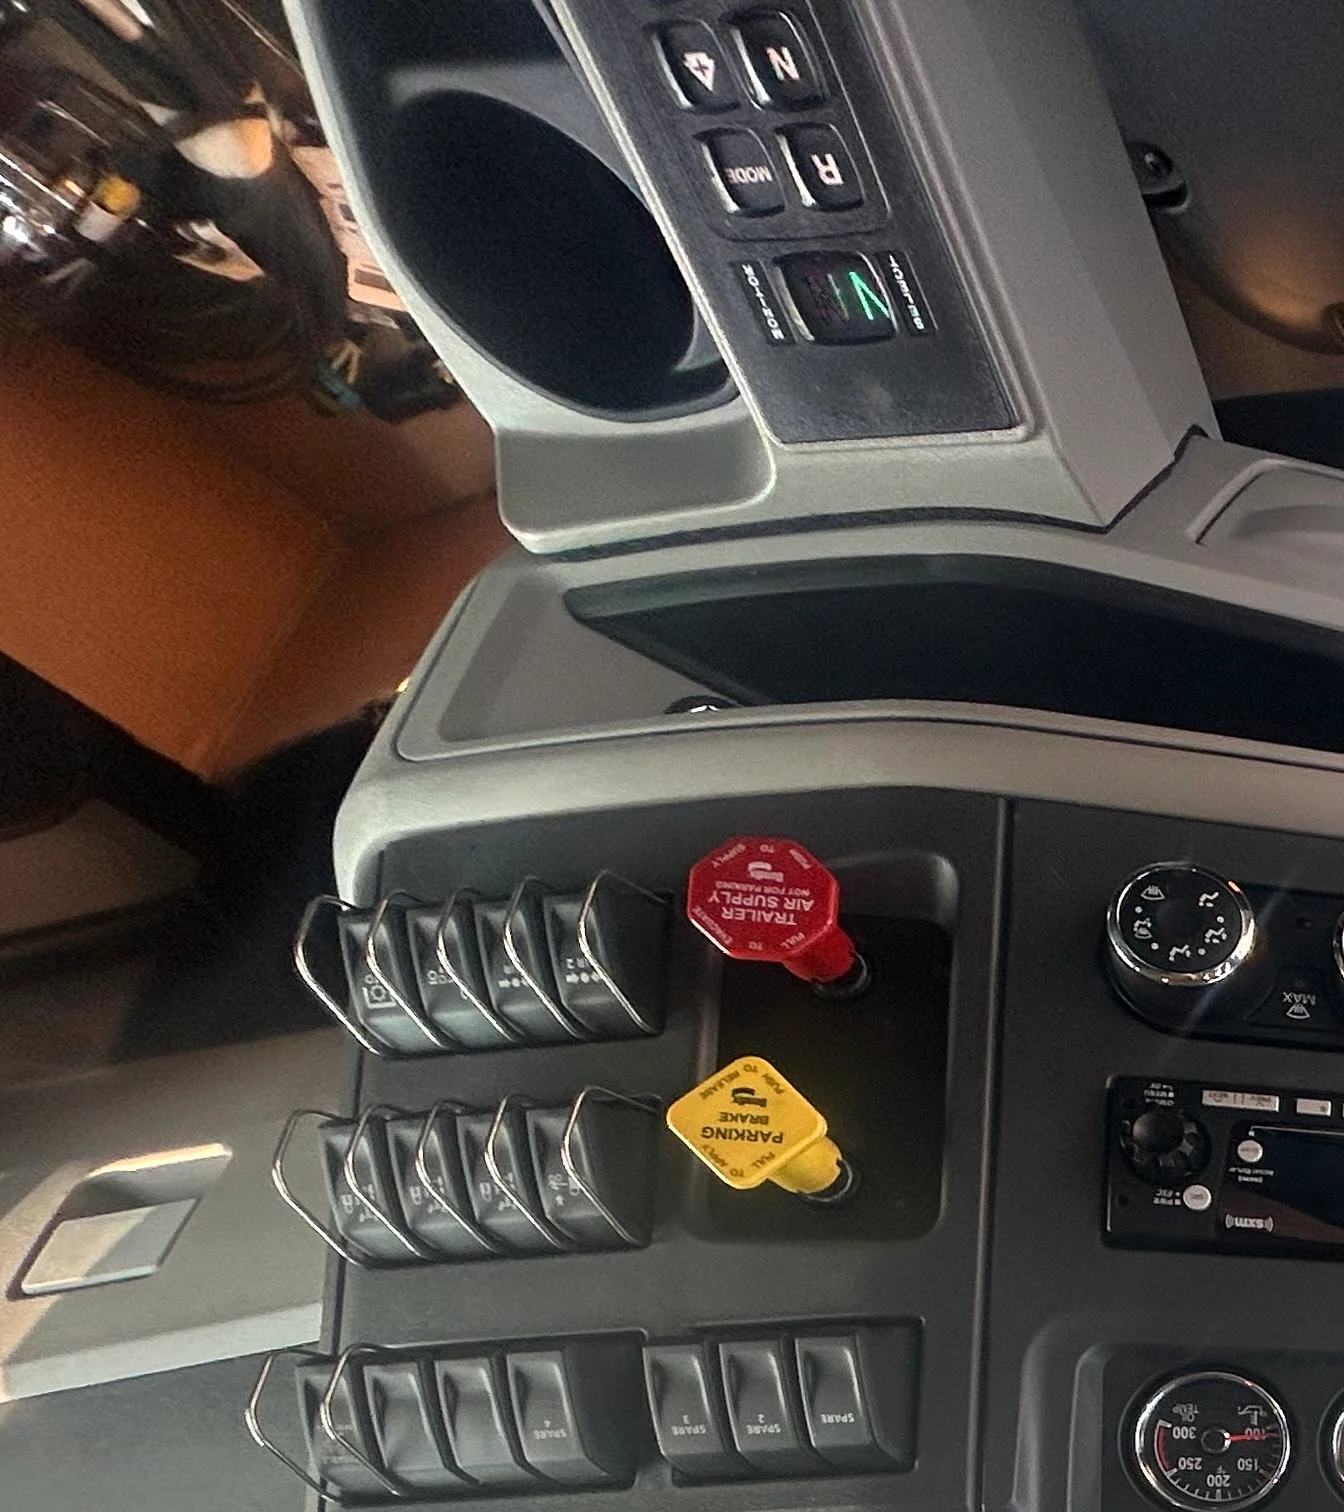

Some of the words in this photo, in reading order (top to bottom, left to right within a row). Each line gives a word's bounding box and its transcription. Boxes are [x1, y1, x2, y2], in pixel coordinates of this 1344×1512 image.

[765, 46, 800, 83] N
[724, 165, 773, 184] MODE
[810, 152, 844, 186] R
[887, 254, 924, 330] SELECT
[741, 263, 785, 340] MONITOR
[759, 844, 775, 854] TO
[715, 880, 762, 893] PARKING
[763, 885, 786, 896] FOR
[787, 887, 810, 898] NOT
[707, 889, 779, 909] SUPPLY
[783, 896, 815, 912] AIR
[721, 906, 798, 926] TRAILER
[748, 941, 764, 951] TO
[780, 932, 806, 950] PULL
[1282, 991, 1316, 1006] MAX
[743, 1064, 758, 1074] TO
[698, 1070, 740, 1100] RELEASE
[718, 1111, 769, 1126] BRAKE
[700, 1126, 784, 1145] PARKING
[701, 1143, 729, 1168] APPLY
[751, 1151, 776, 1169] PULL
[729, 1168, 744, 1178] TO
[1234, 1217, 1265, 1229] sxm
[1172, 1403, 1198, 1413] TEMP
[756, 1413, 766, 1423] 2
[819, 1412, 855, 1424] SPARE
[533, 1427, 568, 1440] SPARE
[670, 1424, 707, 1437] SPARE
[745, 1423, 782, 1436] SPARE
[1172, 1427, 1197, 1439] 300
[1178, 1457, 1202, 1471] 250
[1236, 1458, 1259, 1471] 150
[1206, 1474, 1231, 1487] 200
